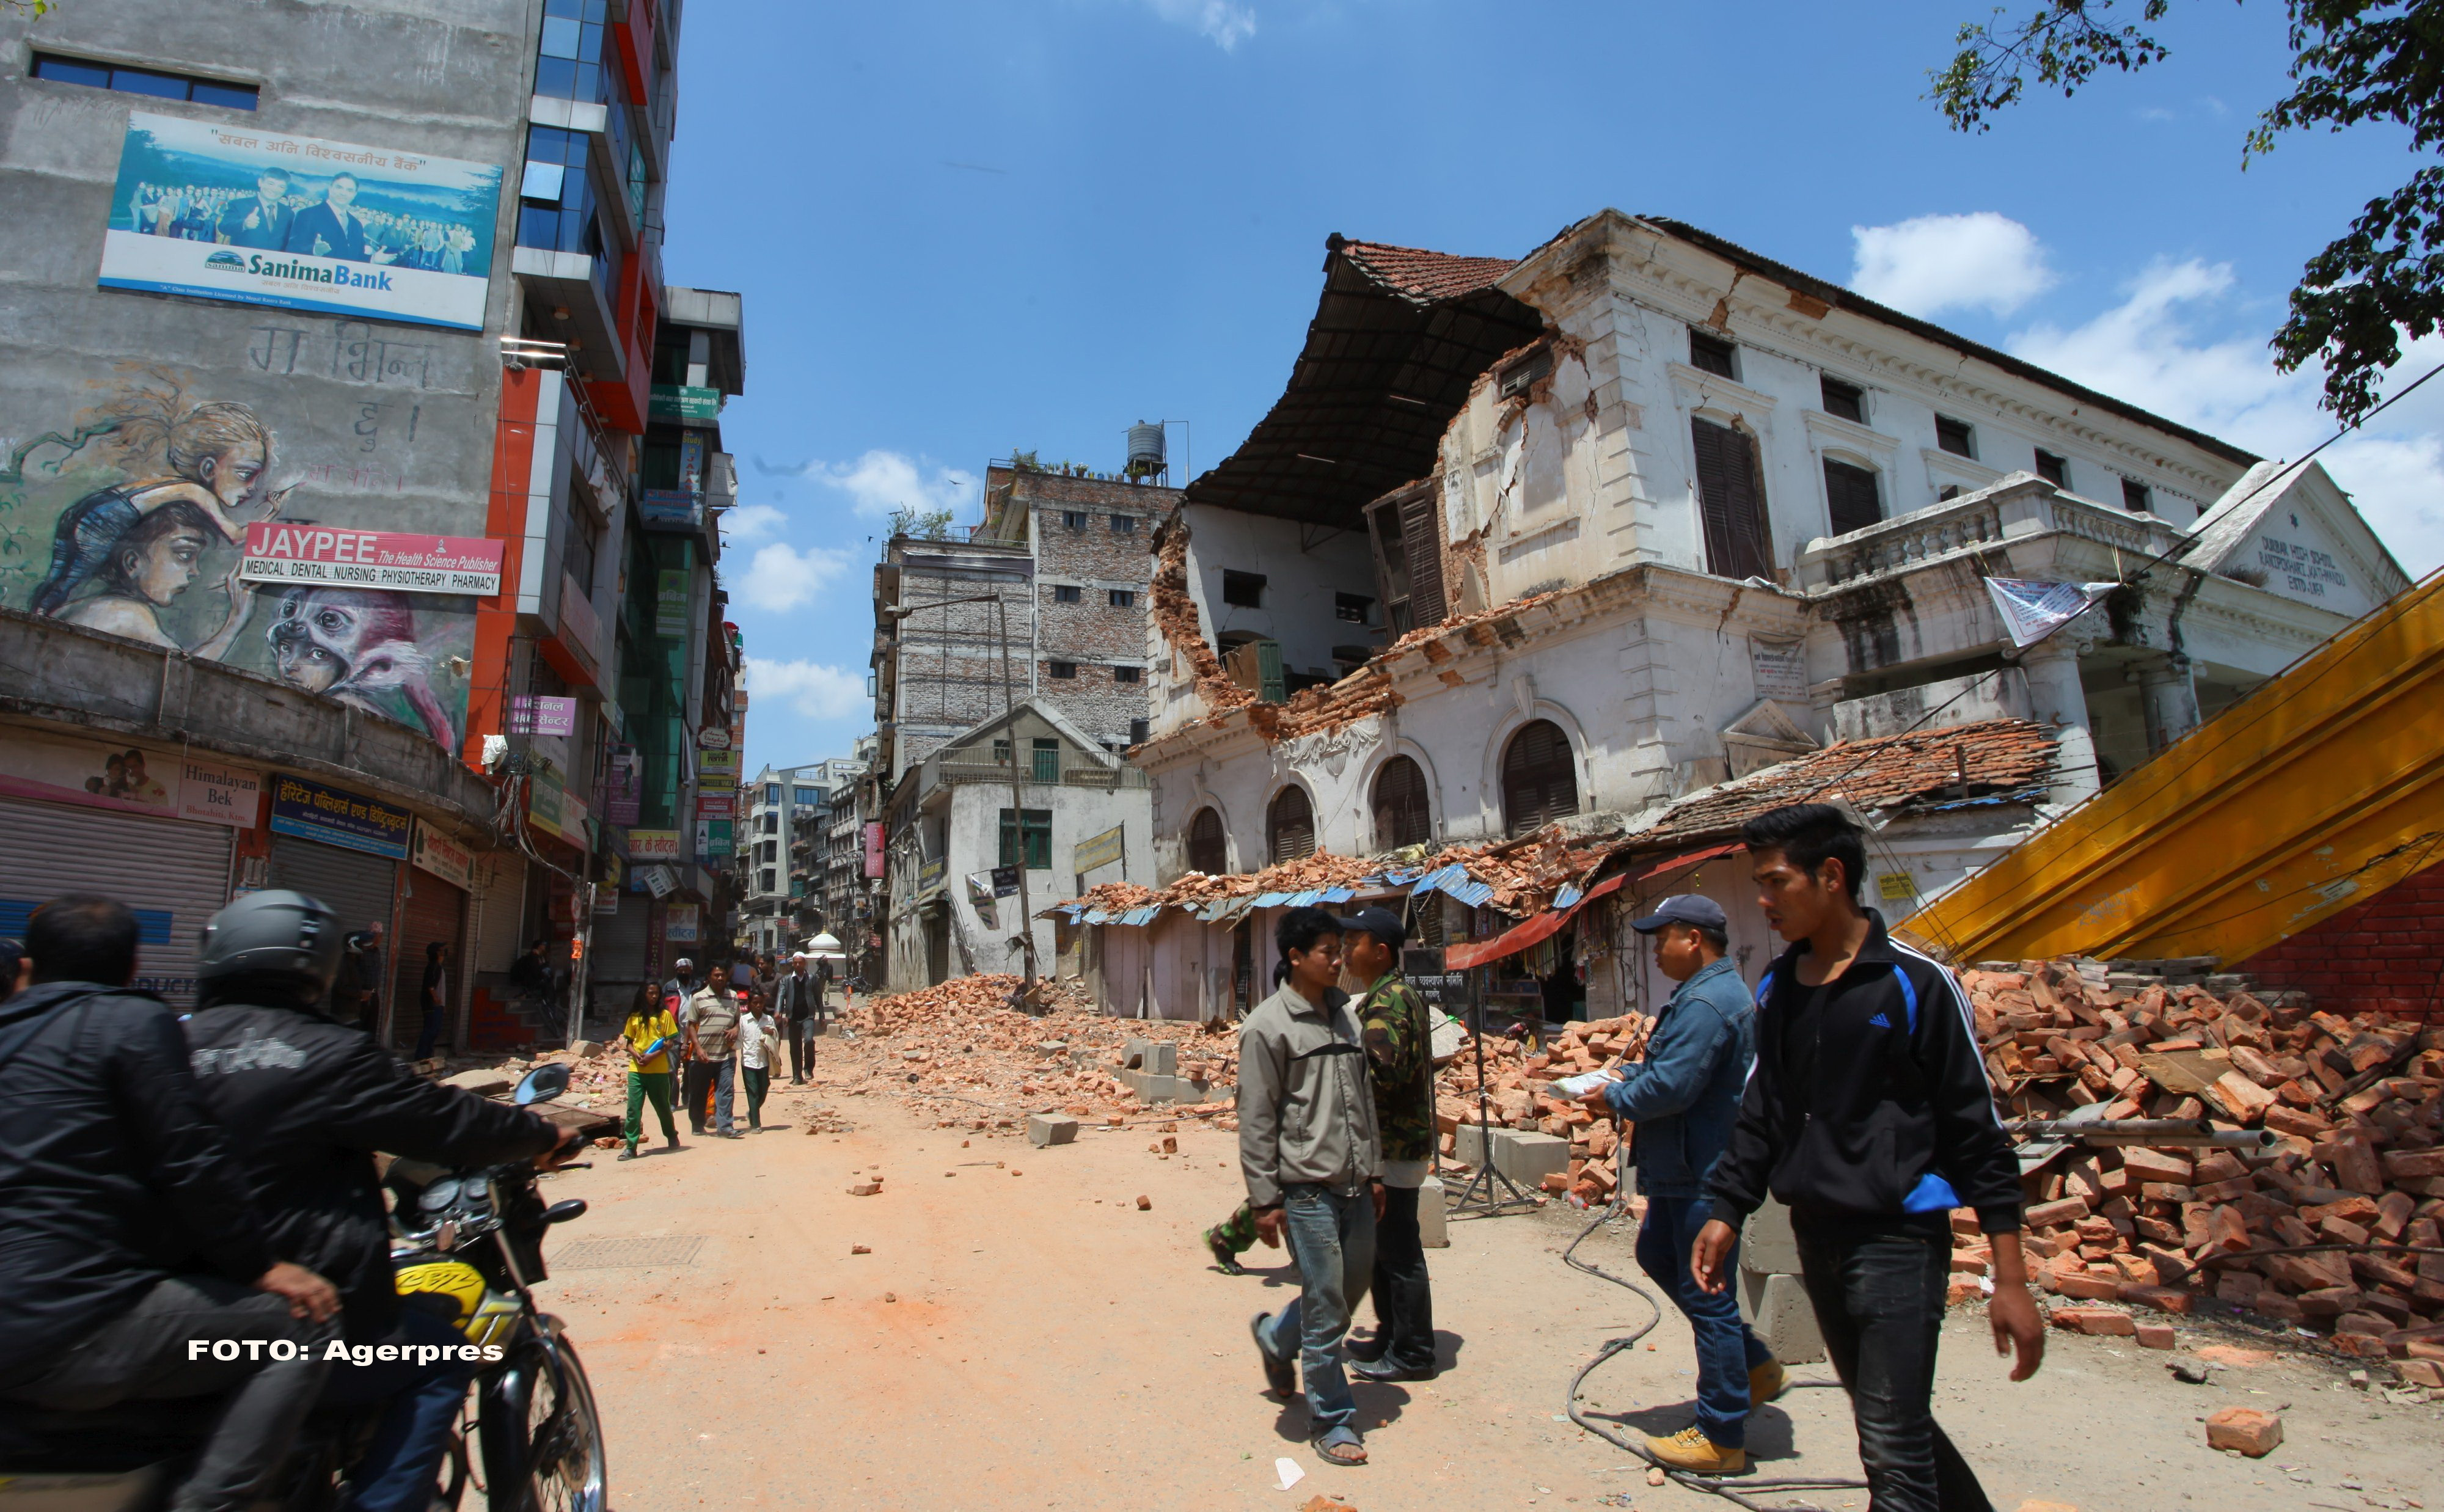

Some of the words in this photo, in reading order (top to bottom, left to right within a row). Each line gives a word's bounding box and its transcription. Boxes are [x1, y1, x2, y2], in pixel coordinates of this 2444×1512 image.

[266, 140, 300, 155] अनि
[306, 144, 388, 167] विश्वसनीय
[205, 261, 244, 273] sanima
[248, 254, 393, 291] SanimaBank
[186, 287, 213, 297] Institution
[214, 290, 237, 299] Licensed
[246, 294, 262, 304] Nepal
[262, 279, 281, 288] सबल
[284, 280, 299, 290] अनि
[301, 282, 340, 295] विश्वसनीय
[682, 434, 701, 446] Study
[251, 527, 378, 563] JAYPEE
[2261, 536, 2289, 557] DURBAR
[2289, 544, 2309, 562] HIGH
[378, 550, 389, 564] The
[396, 551, 423, 566] Health
[423, 553, 456, 568] Science
[458, 556, 499, 572] Publisher
[246, 560, 284, 575] MEDICAL
[291, 562, 327, 578] DENTAL
[334, 565, 376, 582] NURSING
[381, 569, 447, 586] PHYSIOTHERAPY
[452, 574, 496, 591] PHARMACY
[538, 713, 570, 726] सेन्टर
[185, 764, 257, 792] Himalayan
[207, 787, 233, 807] Bek
[280, 780, 312, 805] हेरिटेज
[351, 803, 368, 820] एण्ड
[629, 839, 643, 853] आर.
[645, 836, 653, 852] के
[1446, 972, 1463, 987] समिति
